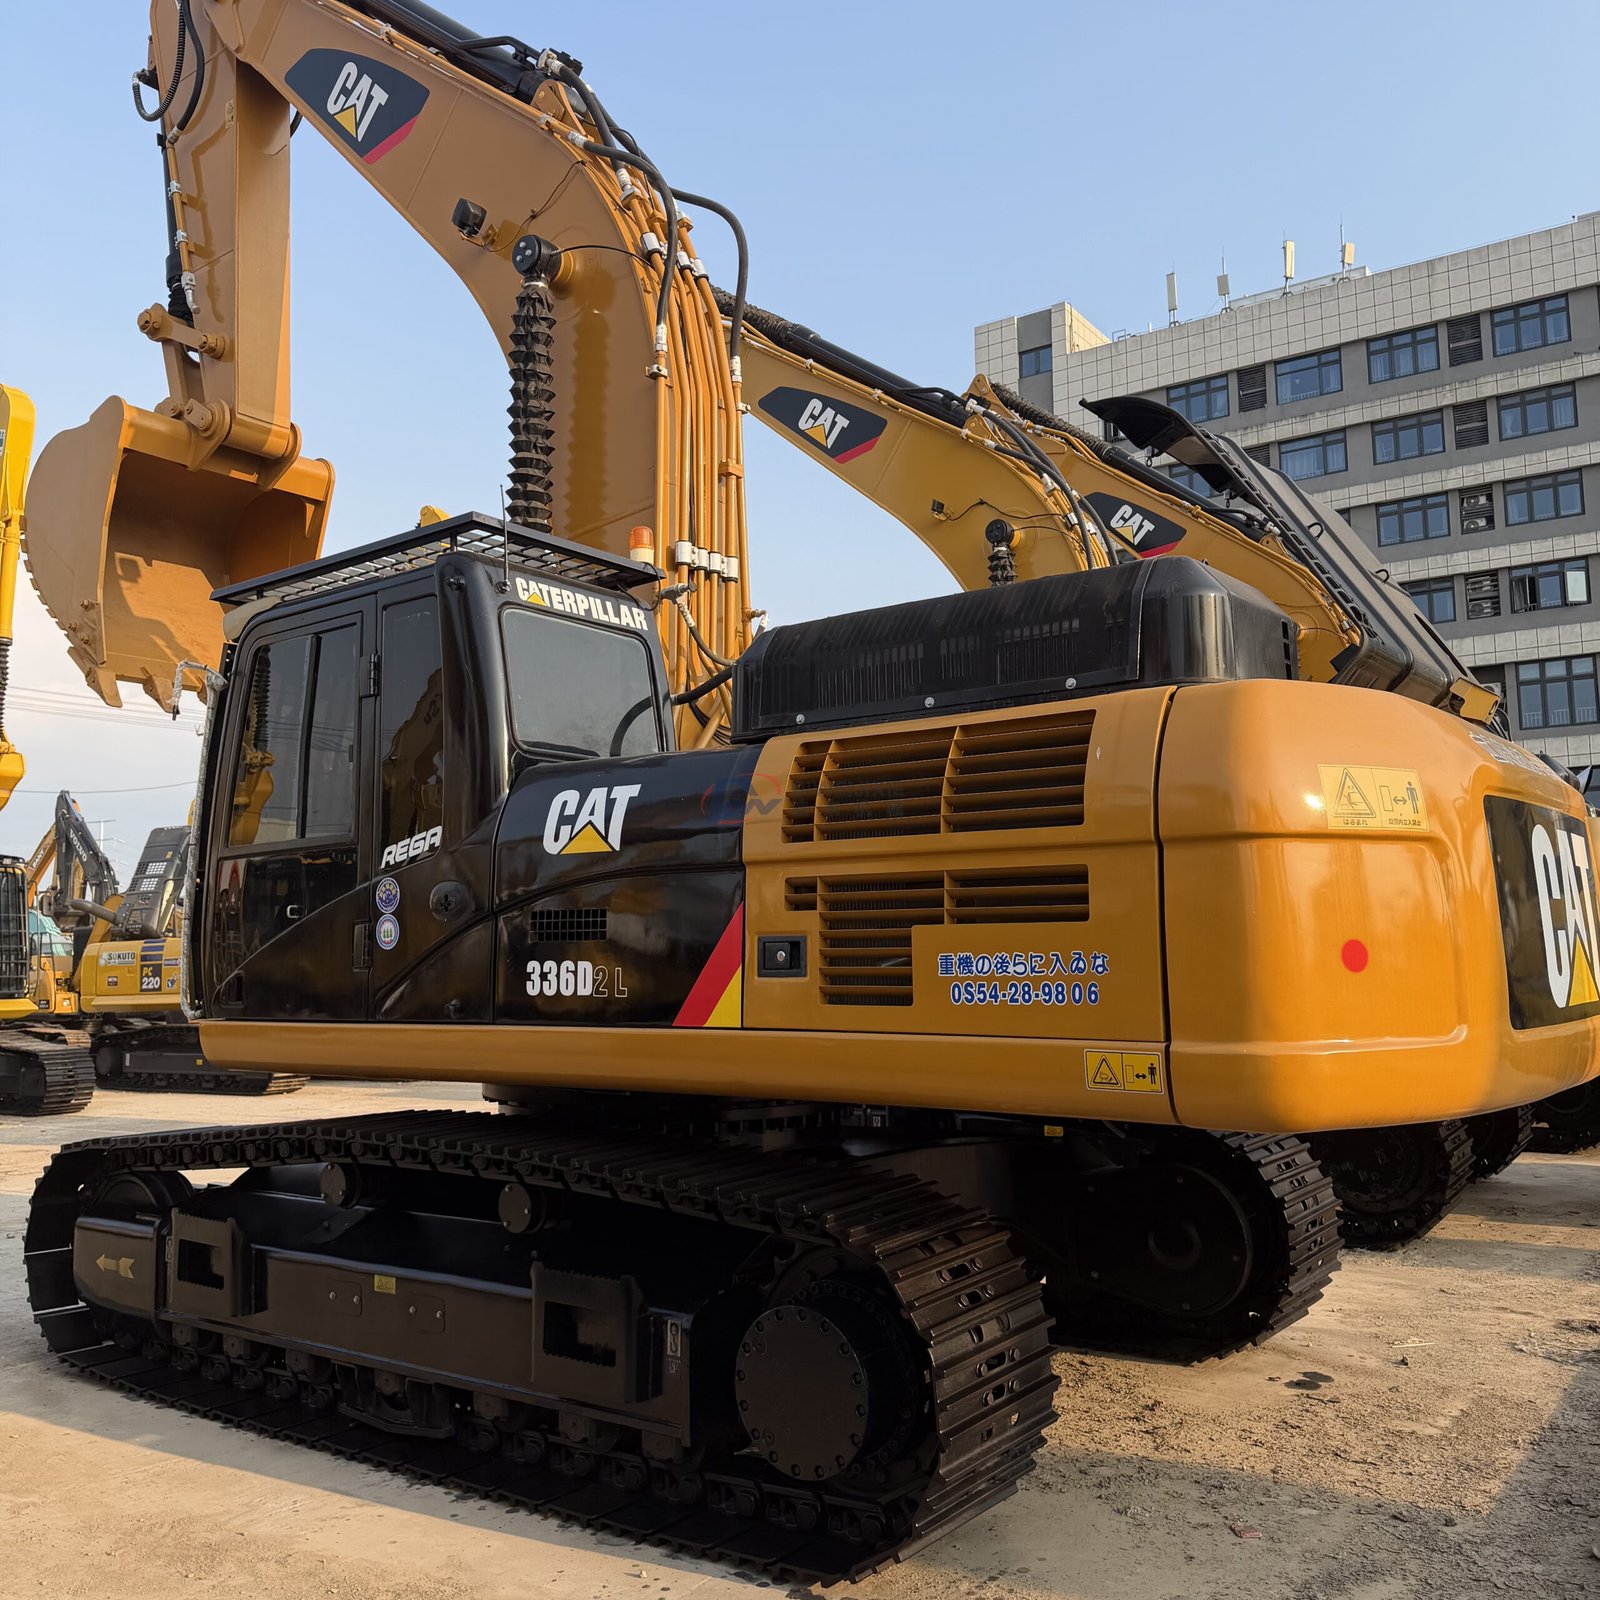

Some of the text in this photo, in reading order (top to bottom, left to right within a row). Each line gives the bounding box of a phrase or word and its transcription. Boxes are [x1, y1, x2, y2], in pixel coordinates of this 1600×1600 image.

[327, 61, 389, 142] CAT
[798, 398, 850, 449] CAT
[1110, 504, 1155, 546] CAT
[515, 577, 648, 631] CATERPILLAR
[542, 783, 642, 855] CAT
[70, 828, 88, 862] VOLVO
[1532, 824, 1600, 1008] CAT
[142, 977, 160, 989] 220
[143, 967, 153, 976] PC
